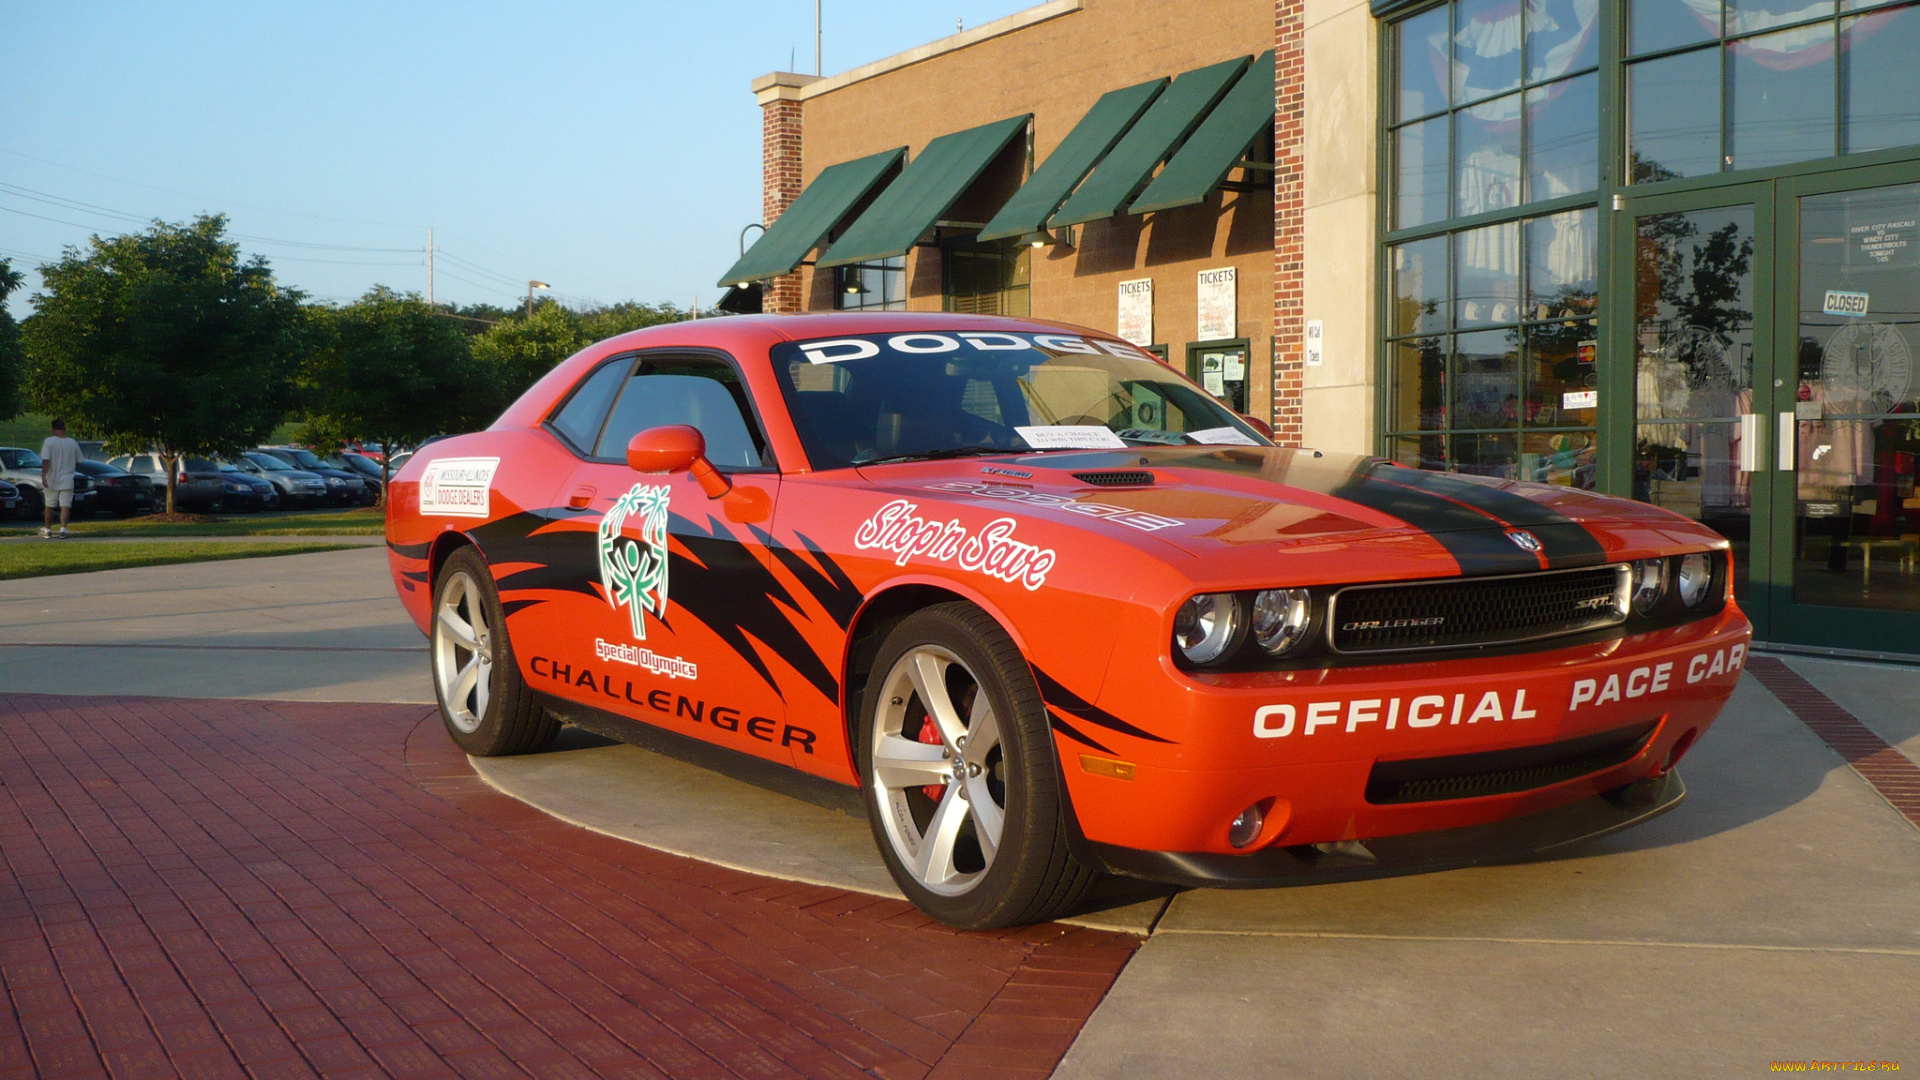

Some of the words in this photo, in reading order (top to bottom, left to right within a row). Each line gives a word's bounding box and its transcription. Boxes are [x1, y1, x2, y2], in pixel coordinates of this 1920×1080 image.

[1871, 223, 1886, 231] CITY
[1887, 220, 1916, 229] RASCALS
[1861, 240, 1907, 251] THUNDERBOLTS
[1884, 233, 1899, 241] CITY
[1869, 249, 1895, 258] TONIGHT
[1199, 269, 1234, 285] TICKETS
[1119, 280, 1150, 295] TICKETS
[1826, 294, 1866, 312] CLOSED
[799, 333, 1156, 365] DODGE
[438, 489, 458, 505] DODGE
[459, 489, 485, 506] DEALERS
[923, 481, 1186, 532] DODGE
[958, 517, 1056, 591] Save
[1342, 616, 1445, 631] CHALLENGER
[596, 638, 639, 665] Special
[639, 647, 697, 679] Olympics
[1253, 689, 1537, 739] OFFICIAL
[1569, 662, 1673, 711] PACE
[1686, 643, 1745, 684] CAR
[530, 656, 817, 754] CHALLENGER
